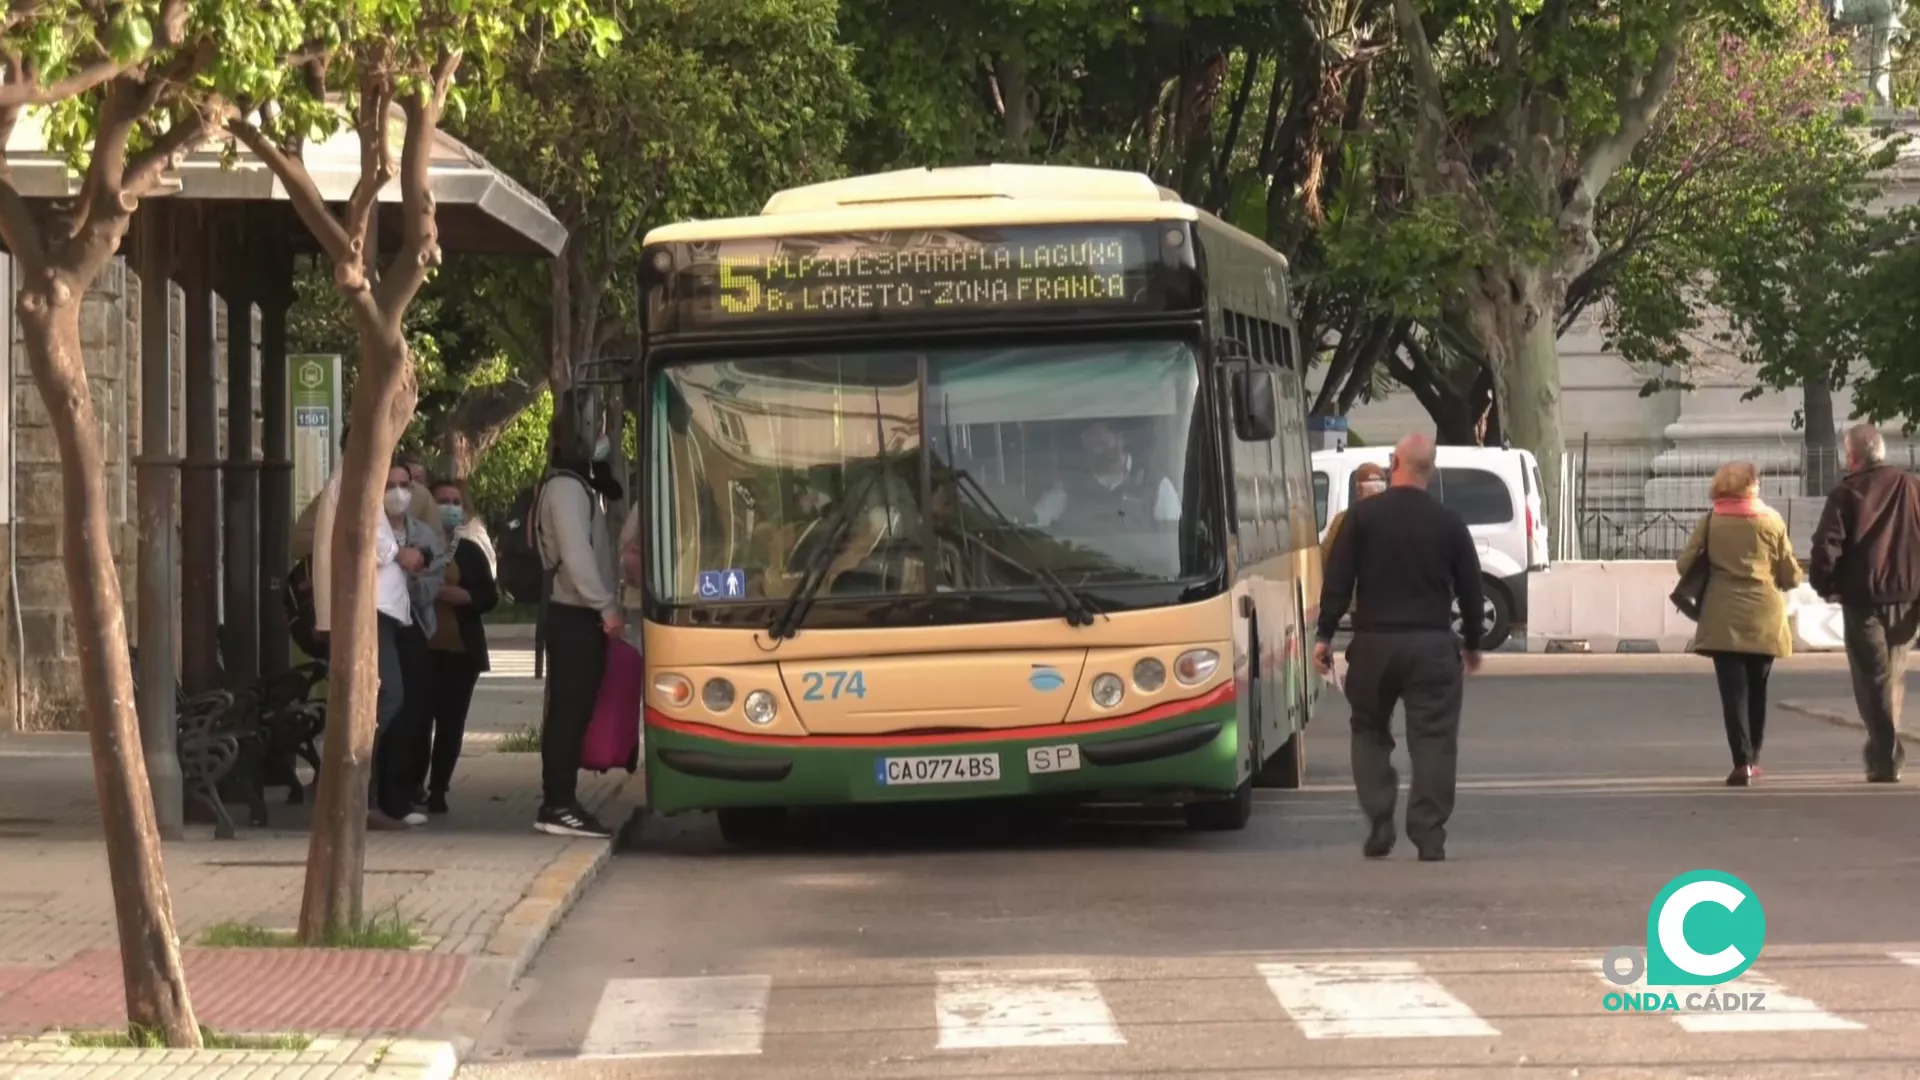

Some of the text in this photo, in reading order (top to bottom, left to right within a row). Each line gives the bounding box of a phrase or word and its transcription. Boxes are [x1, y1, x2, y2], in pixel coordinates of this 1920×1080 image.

[1020, 241, 1123, 269] LAGUNA
[720, 256, 761, 313] 5
[767, 288, 793, 312] B.
[1017, 273, 1125, 301] FRANCA
[298, 413, 325, 425] 1501
[801, 669, 867, 701] 274
